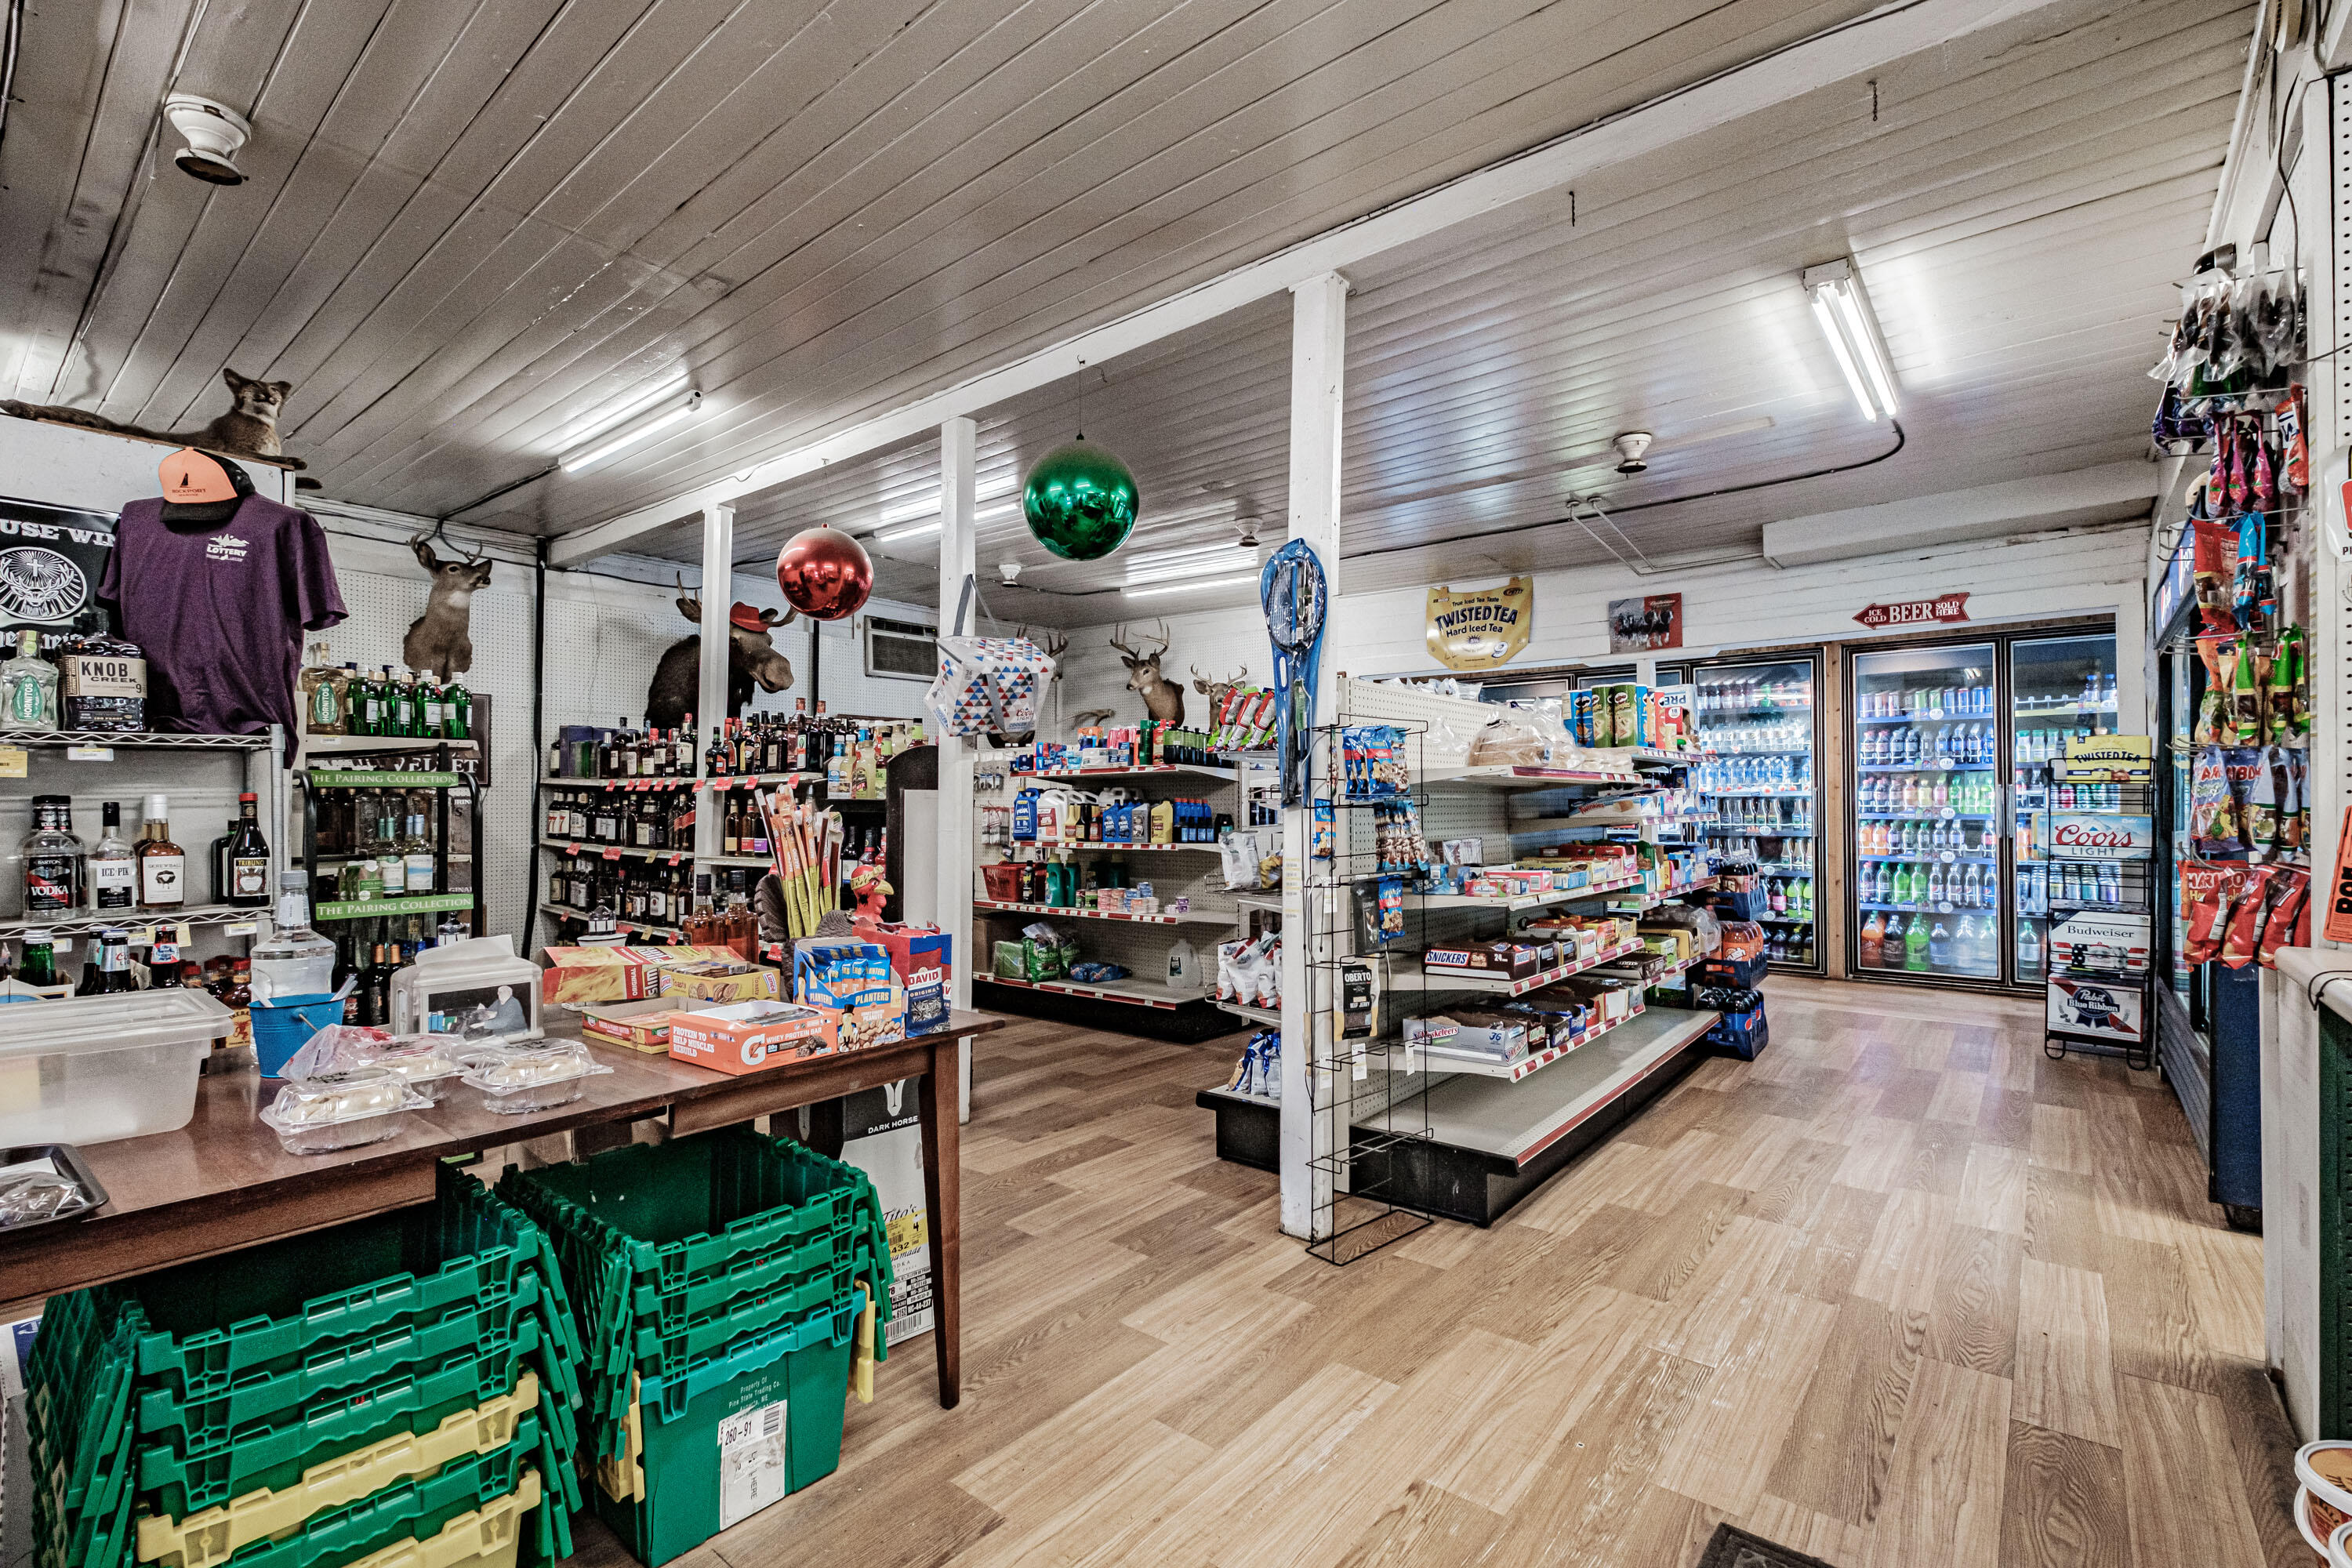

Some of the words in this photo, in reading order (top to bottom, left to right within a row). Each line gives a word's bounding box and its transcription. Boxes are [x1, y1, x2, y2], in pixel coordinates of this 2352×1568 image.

[206, 546, 248, 557] LOTTERY
[1935, 601, 1959, 609] SOLD
[1936, 608, 1959, 616] HERE
[1434, 605, 1492, 631] TWISTED
[1494, 604, 1518, 625] TEA
[1864, 615, 1887, 623] COLD
[1889, 602, 1933, 623] BEER
[1446, 625, 1467, 637] Hard
[1469, 623, 1486, 633] Iced
[1489, 623, 1503, 633] Tea
[1491, 641, 1508, 659] 9
[82, 662, 128, 677] KNOB
[24, 683, 33, 718] HORNITOS
[2074, 751, 2120, 764] TWISTED
[2119, 750, 2141, 764] TEA
[335, 774, 384, 783] PAIRING
[387, 774, 457, 783] COLLECTION
[2054, 824, 2135, 848] Coors
[2071, 847, 2116, 856] LIGHT
[101, 867, 114, 877] ICE
[31, 885, 69, 896] VODKA
[318, 906, 343, 916] THE
[347, 902, 397, 914] PAIRING
[401, 896, 472, 910] COLLECTION
[2067, 925, 2135, 938] Budweiser
[1427, 951, 1467, 964] SNICKERS
[1494, 953, 1501, 962] 24
[766, 973, 775, 992] Lance
[909, 971, 939, 985] DAVID
[1345, 972, 1371, 982] OBERTO
[909, 985, 940, 997] ORIGINAL
[2080, 989, 2106, 1001] Pabst
[855, 992, 890, 1005] PLANTERS
[2069, 999, 2088, 1009] Blue
[2088, 1002, 2118, 1013] Ribbon
[673, 1026, 697, 1040] PROTEIN
[699, 1033, 707, 1042] TO
[766, 1035, 784, 1044] WHEY
[785, 1030, 809, 1040] PROTEIN
[810, 1027, 822, 1036] BAR
[1490, 1032, 1501, 1041] 36
[673, 1035, 687, 1046] HELP
[688, 1039, 715, 1054] MUSCLES
[673, 1044, 698, 1058] REBUILD
[741, 1033, 766, 1066] G
[868, 1122, 890, 1134] DARK
[891, 1115, 918, 1128] HORSE
[884, 1204, 917, 1224] Tito's
[913, 1221, 920, 1232] 4
[740, 1380, 760, 1394] Property
[728, 1399, 739, 1409] Pine
[741, 1393, 753, 1403] State
[754, 1385, 772, 1396] Trading
